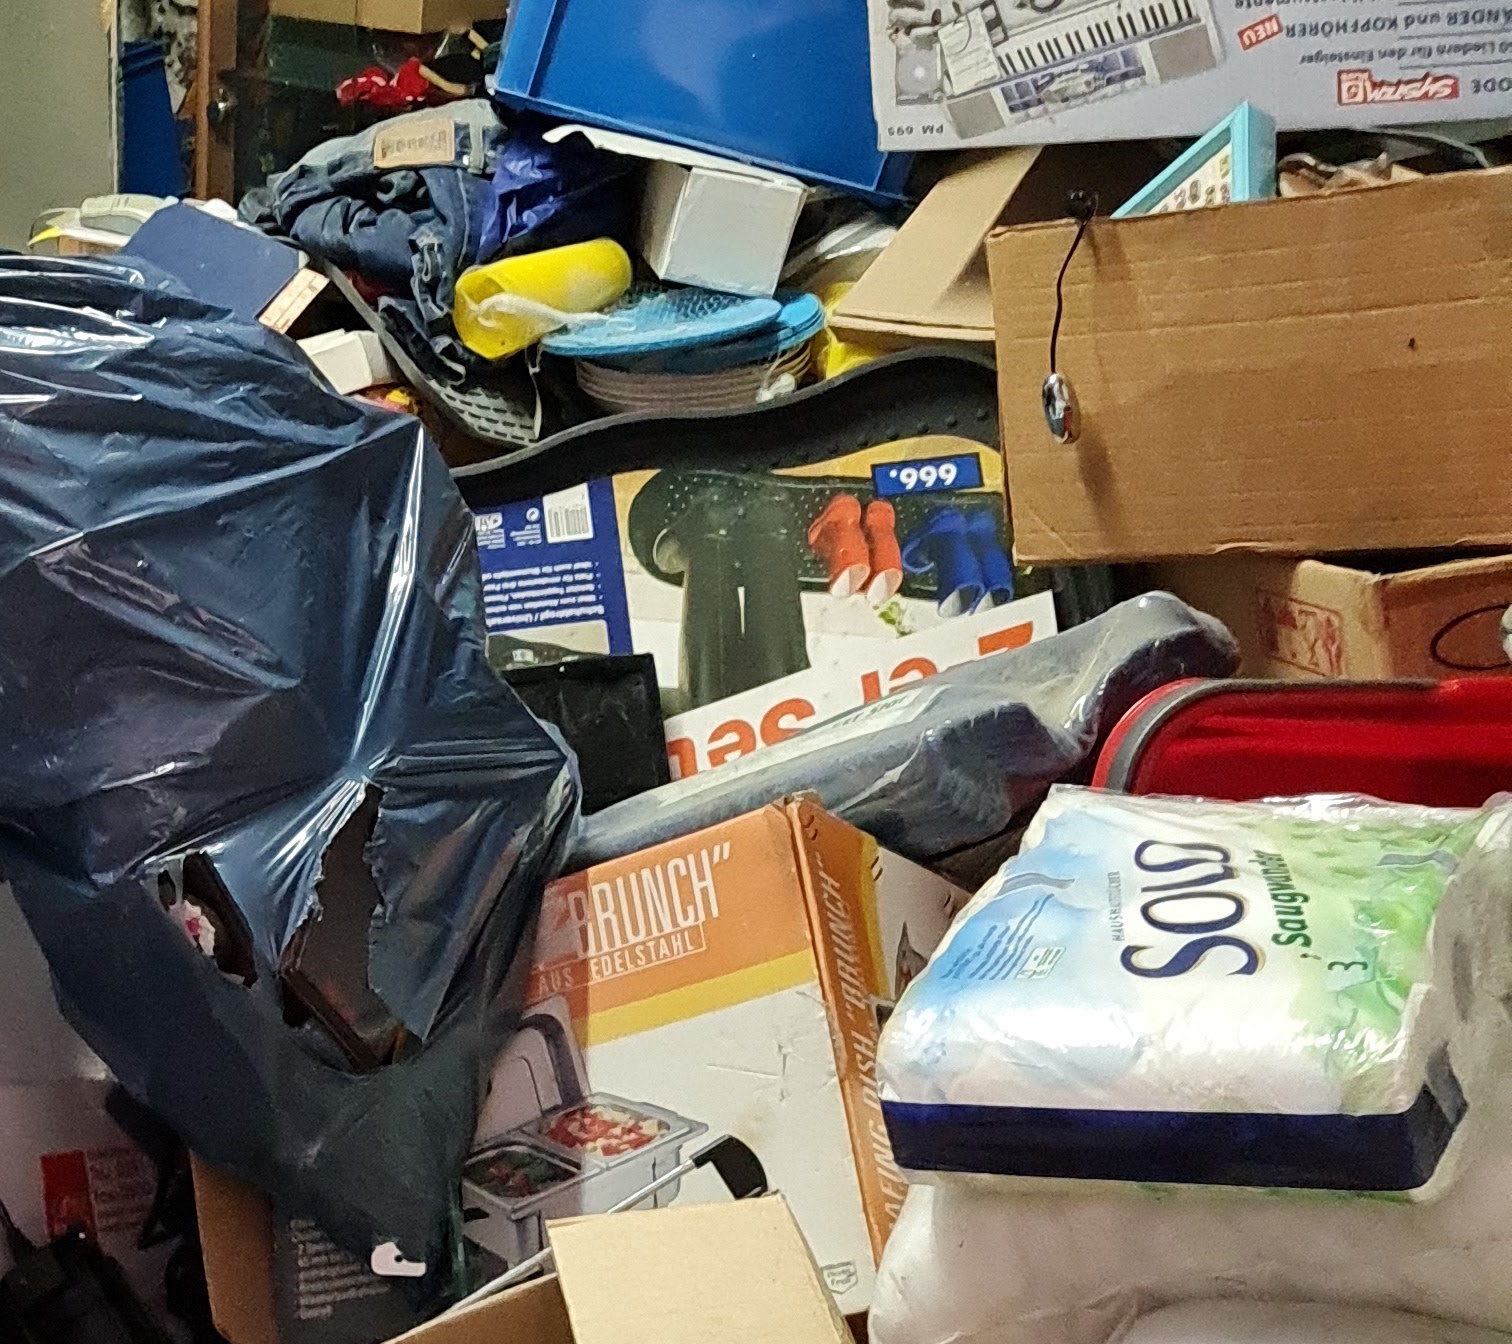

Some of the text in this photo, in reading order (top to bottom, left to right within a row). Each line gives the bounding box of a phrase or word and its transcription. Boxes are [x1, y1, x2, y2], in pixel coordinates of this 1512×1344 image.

[1237, 17, 1279, 47] NEU
[1283, 14, 1399, 39] KOPFHÖRER
[1402, 11, 1441, 27] und
[589, 929, 695, 981] EDELSTAHL
[869, 1119, 905, 1228] AFING
